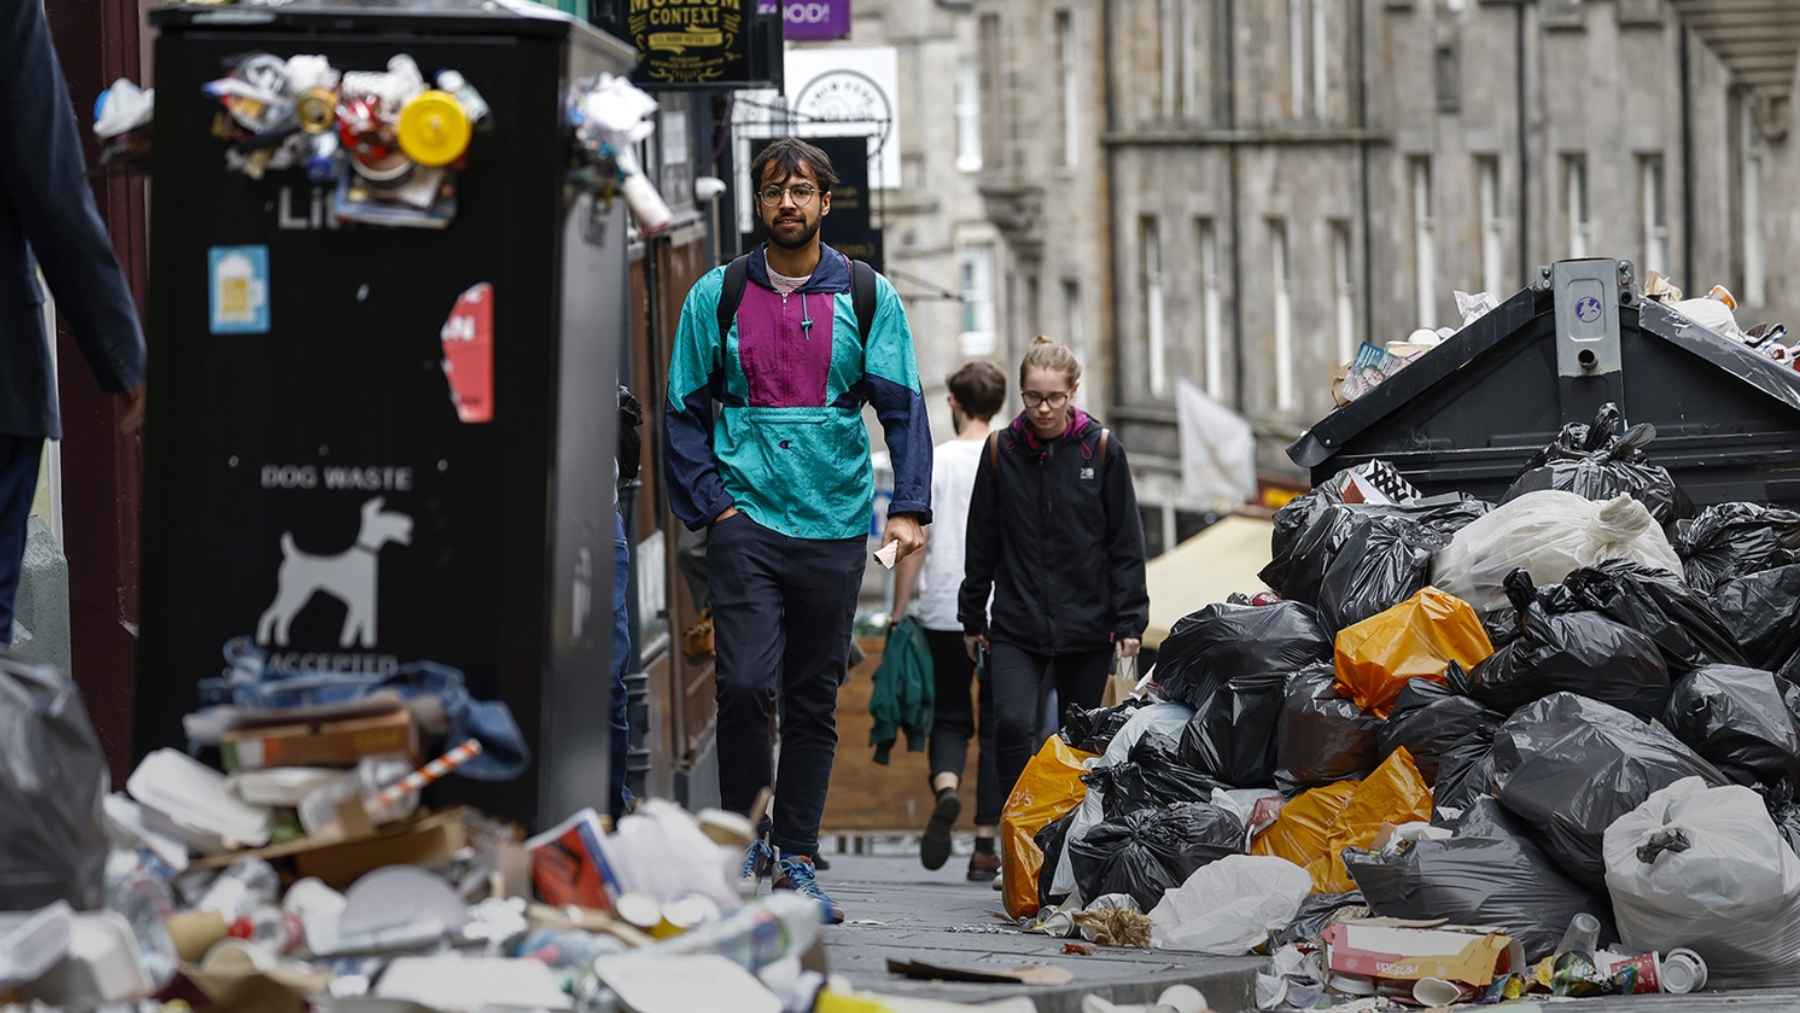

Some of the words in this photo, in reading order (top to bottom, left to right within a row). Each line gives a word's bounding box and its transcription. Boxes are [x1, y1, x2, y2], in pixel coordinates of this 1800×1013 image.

[649, 7, 719, 25] CONTEXT
[260, 464, 318, 489] DOG
[323, 466, 413, 491] WASTE
[270, 651, 399, 675] ACCEPTED
